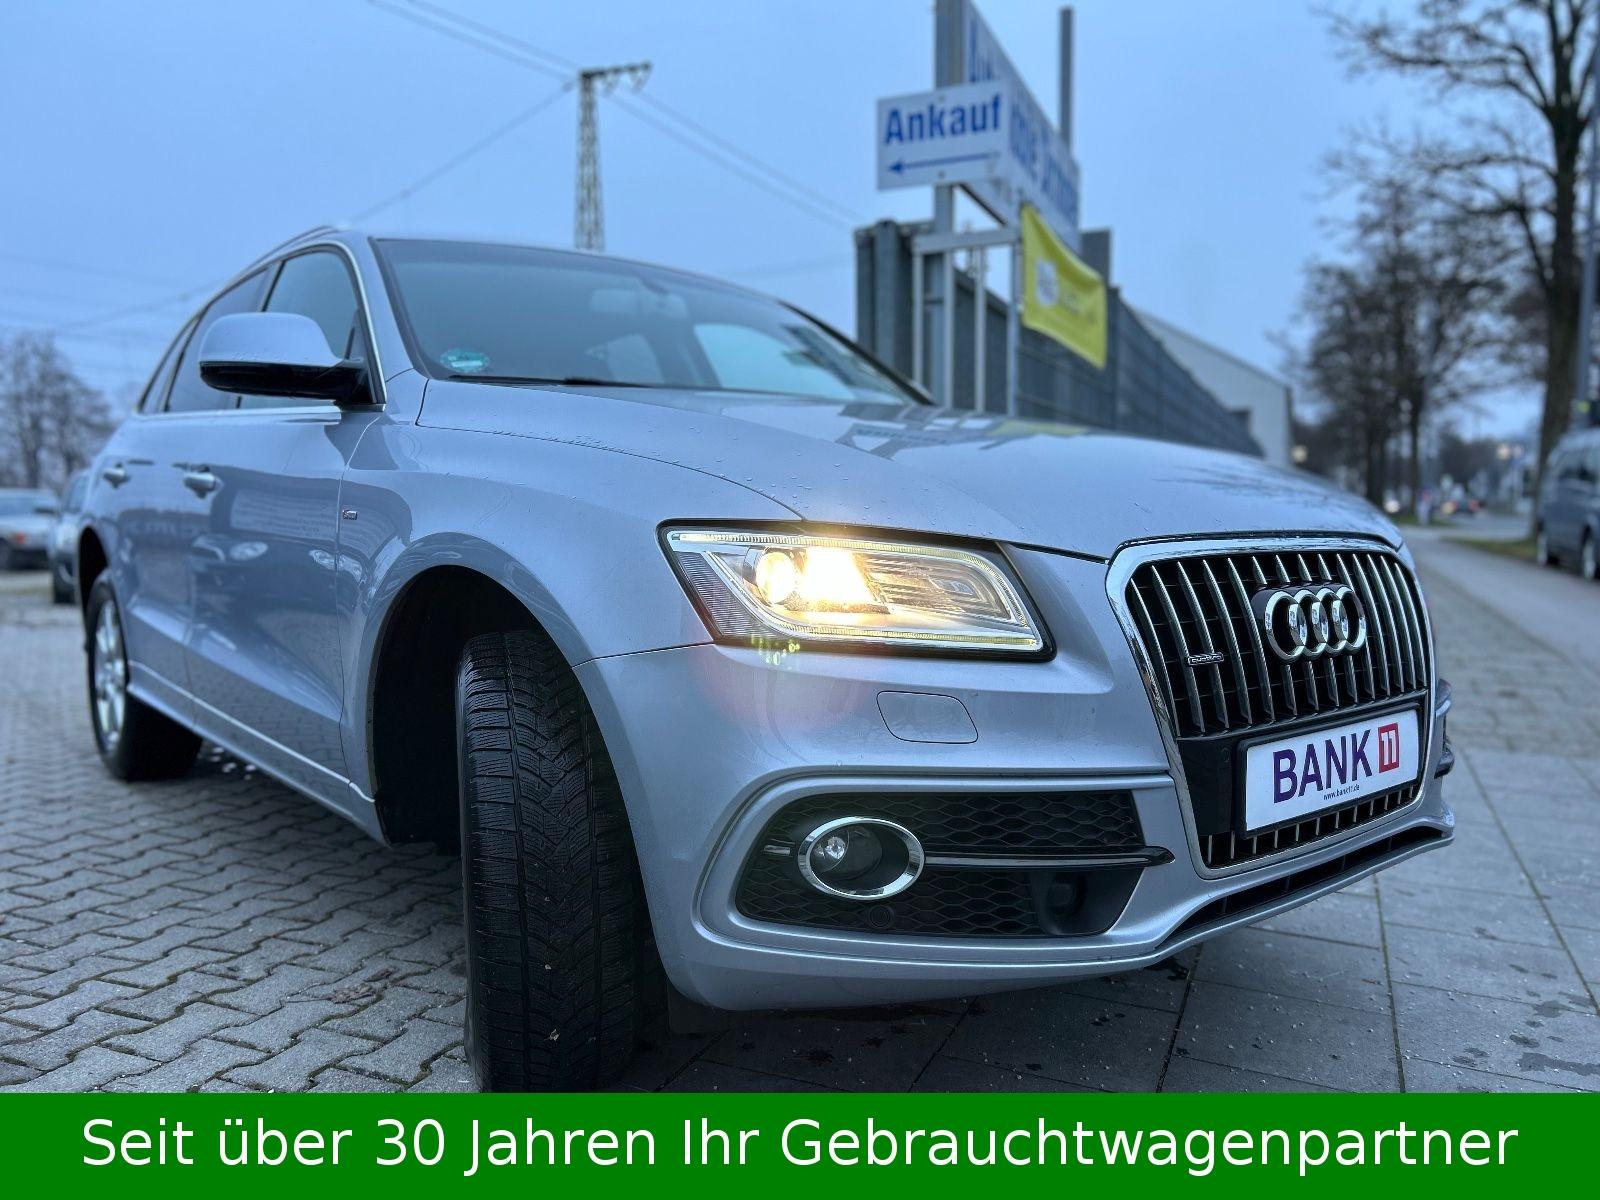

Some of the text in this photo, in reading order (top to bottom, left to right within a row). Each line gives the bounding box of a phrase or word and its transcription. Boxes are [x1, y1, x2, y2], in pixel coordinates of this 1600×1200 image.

[884, 93, 1001, 146] Ankauf
[1273, 729, 1398, 804] BANK 11
